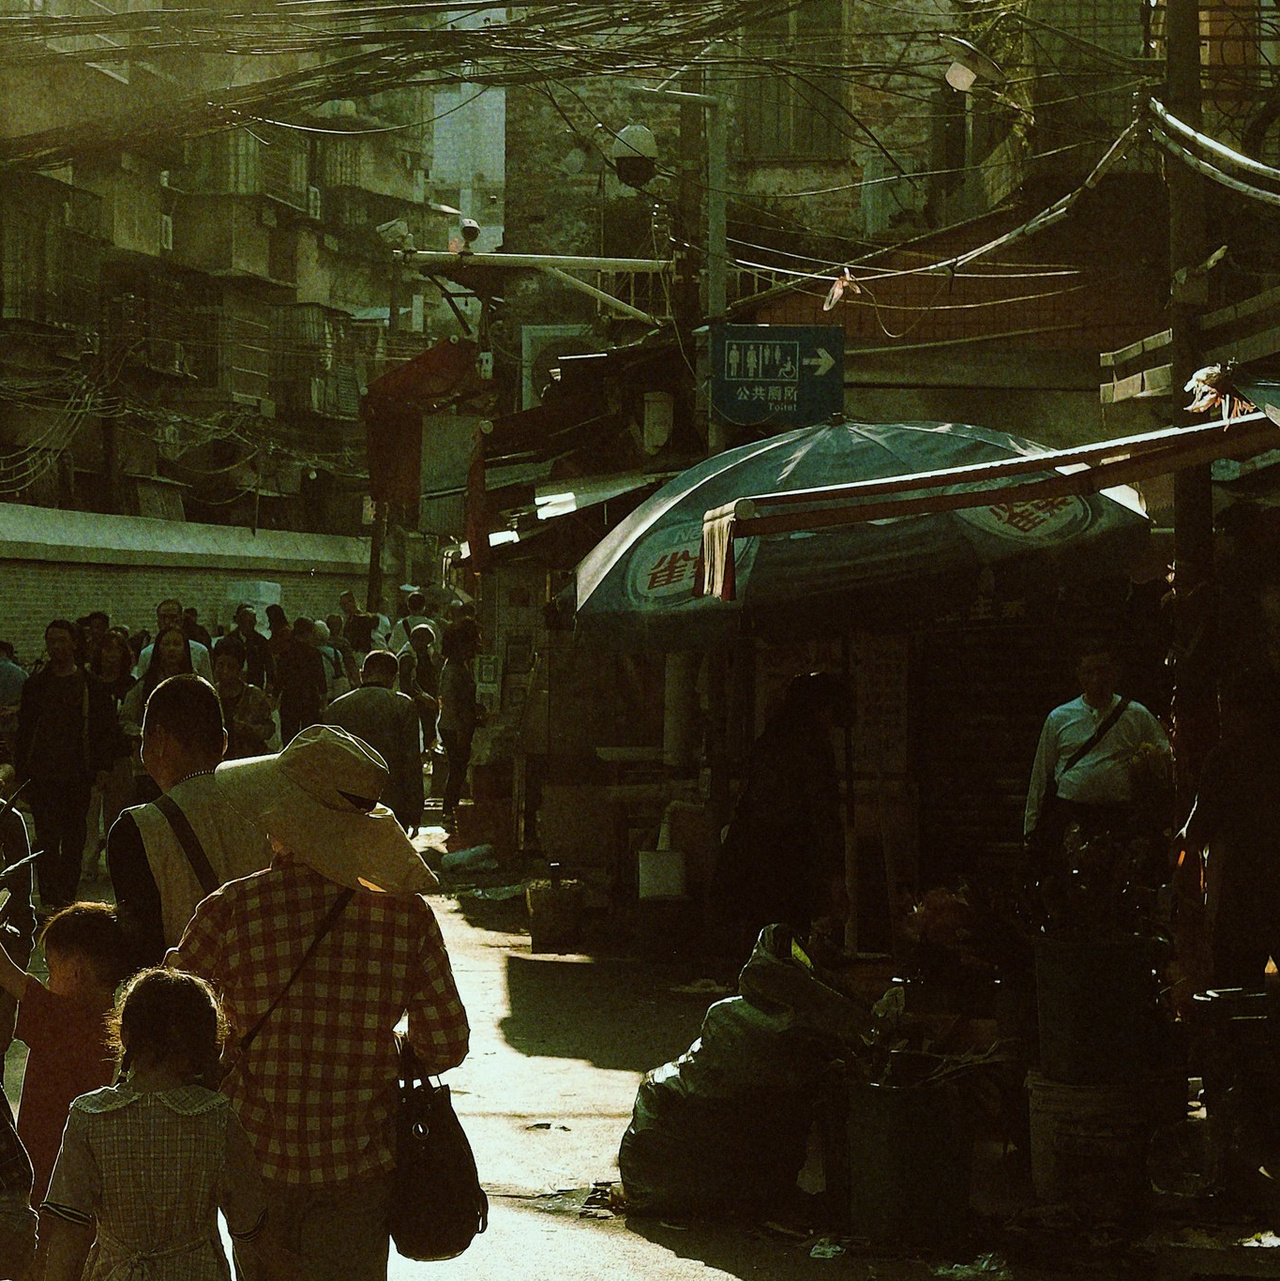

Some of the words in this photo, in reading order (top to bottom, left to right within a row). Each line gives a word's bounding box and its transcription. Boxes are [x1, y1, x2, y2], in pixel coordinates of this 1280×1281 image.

[736, 385, 798, 402] 公共厕所
[647, 549, 704, 590] 雀
